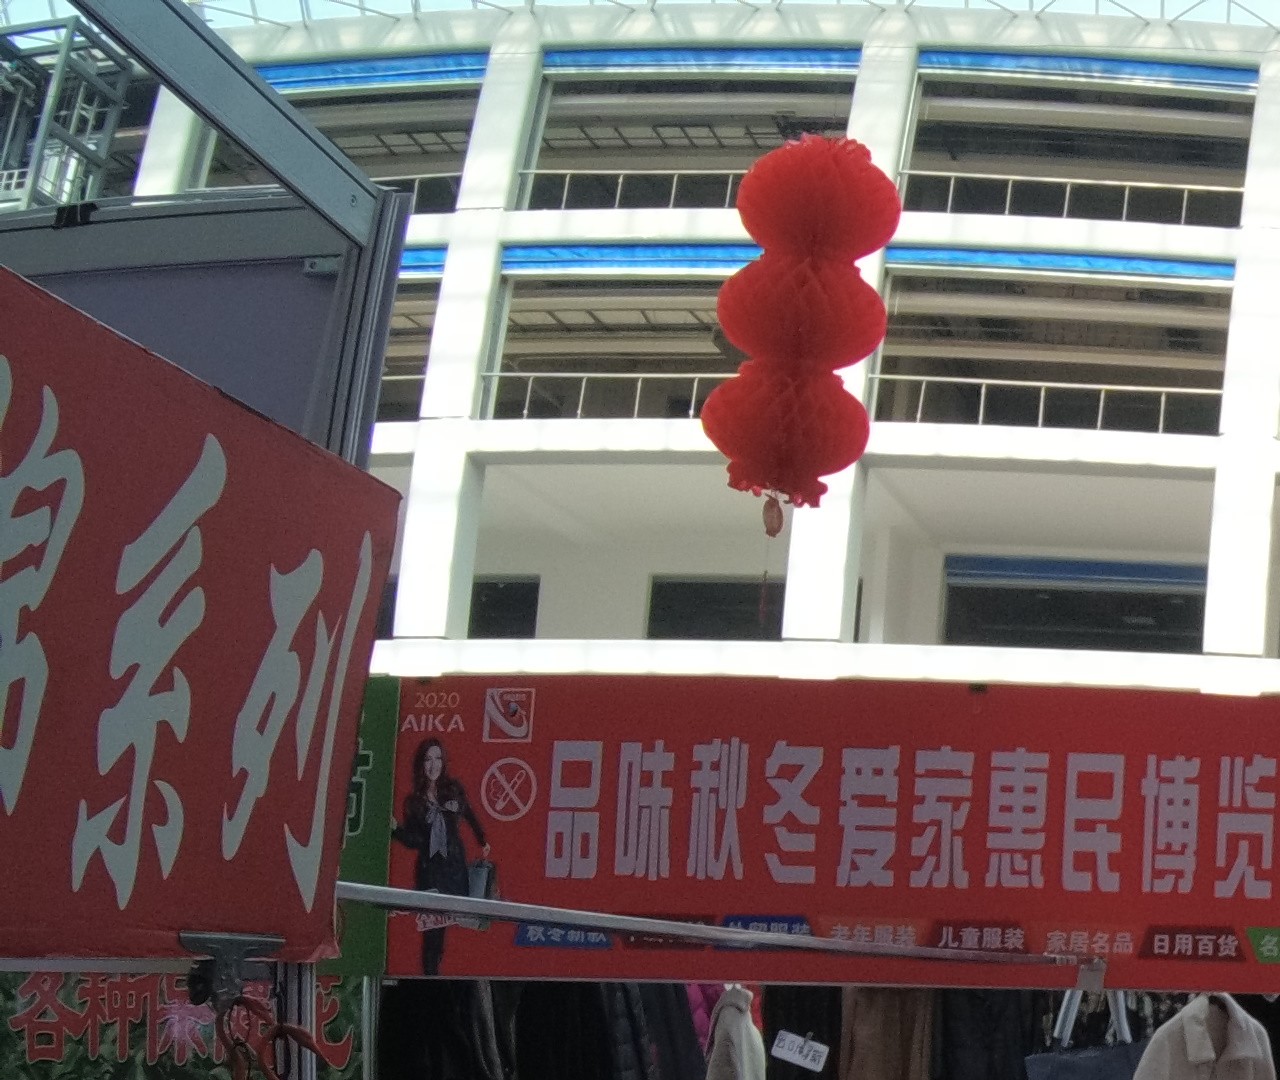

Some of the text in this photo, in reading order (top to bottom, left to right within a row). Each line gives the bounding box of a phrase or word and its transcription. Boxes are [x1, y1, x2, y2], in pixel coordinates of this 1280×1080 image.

[414, 692, 460, 709] 2020
[400, 714, 465, 733] AIKA
[938, 927, 1025, 951] 儿童服装
[1047, 929, 1134, 955] 家居名品
[1153, 935, 1240, 957] 日用百货
